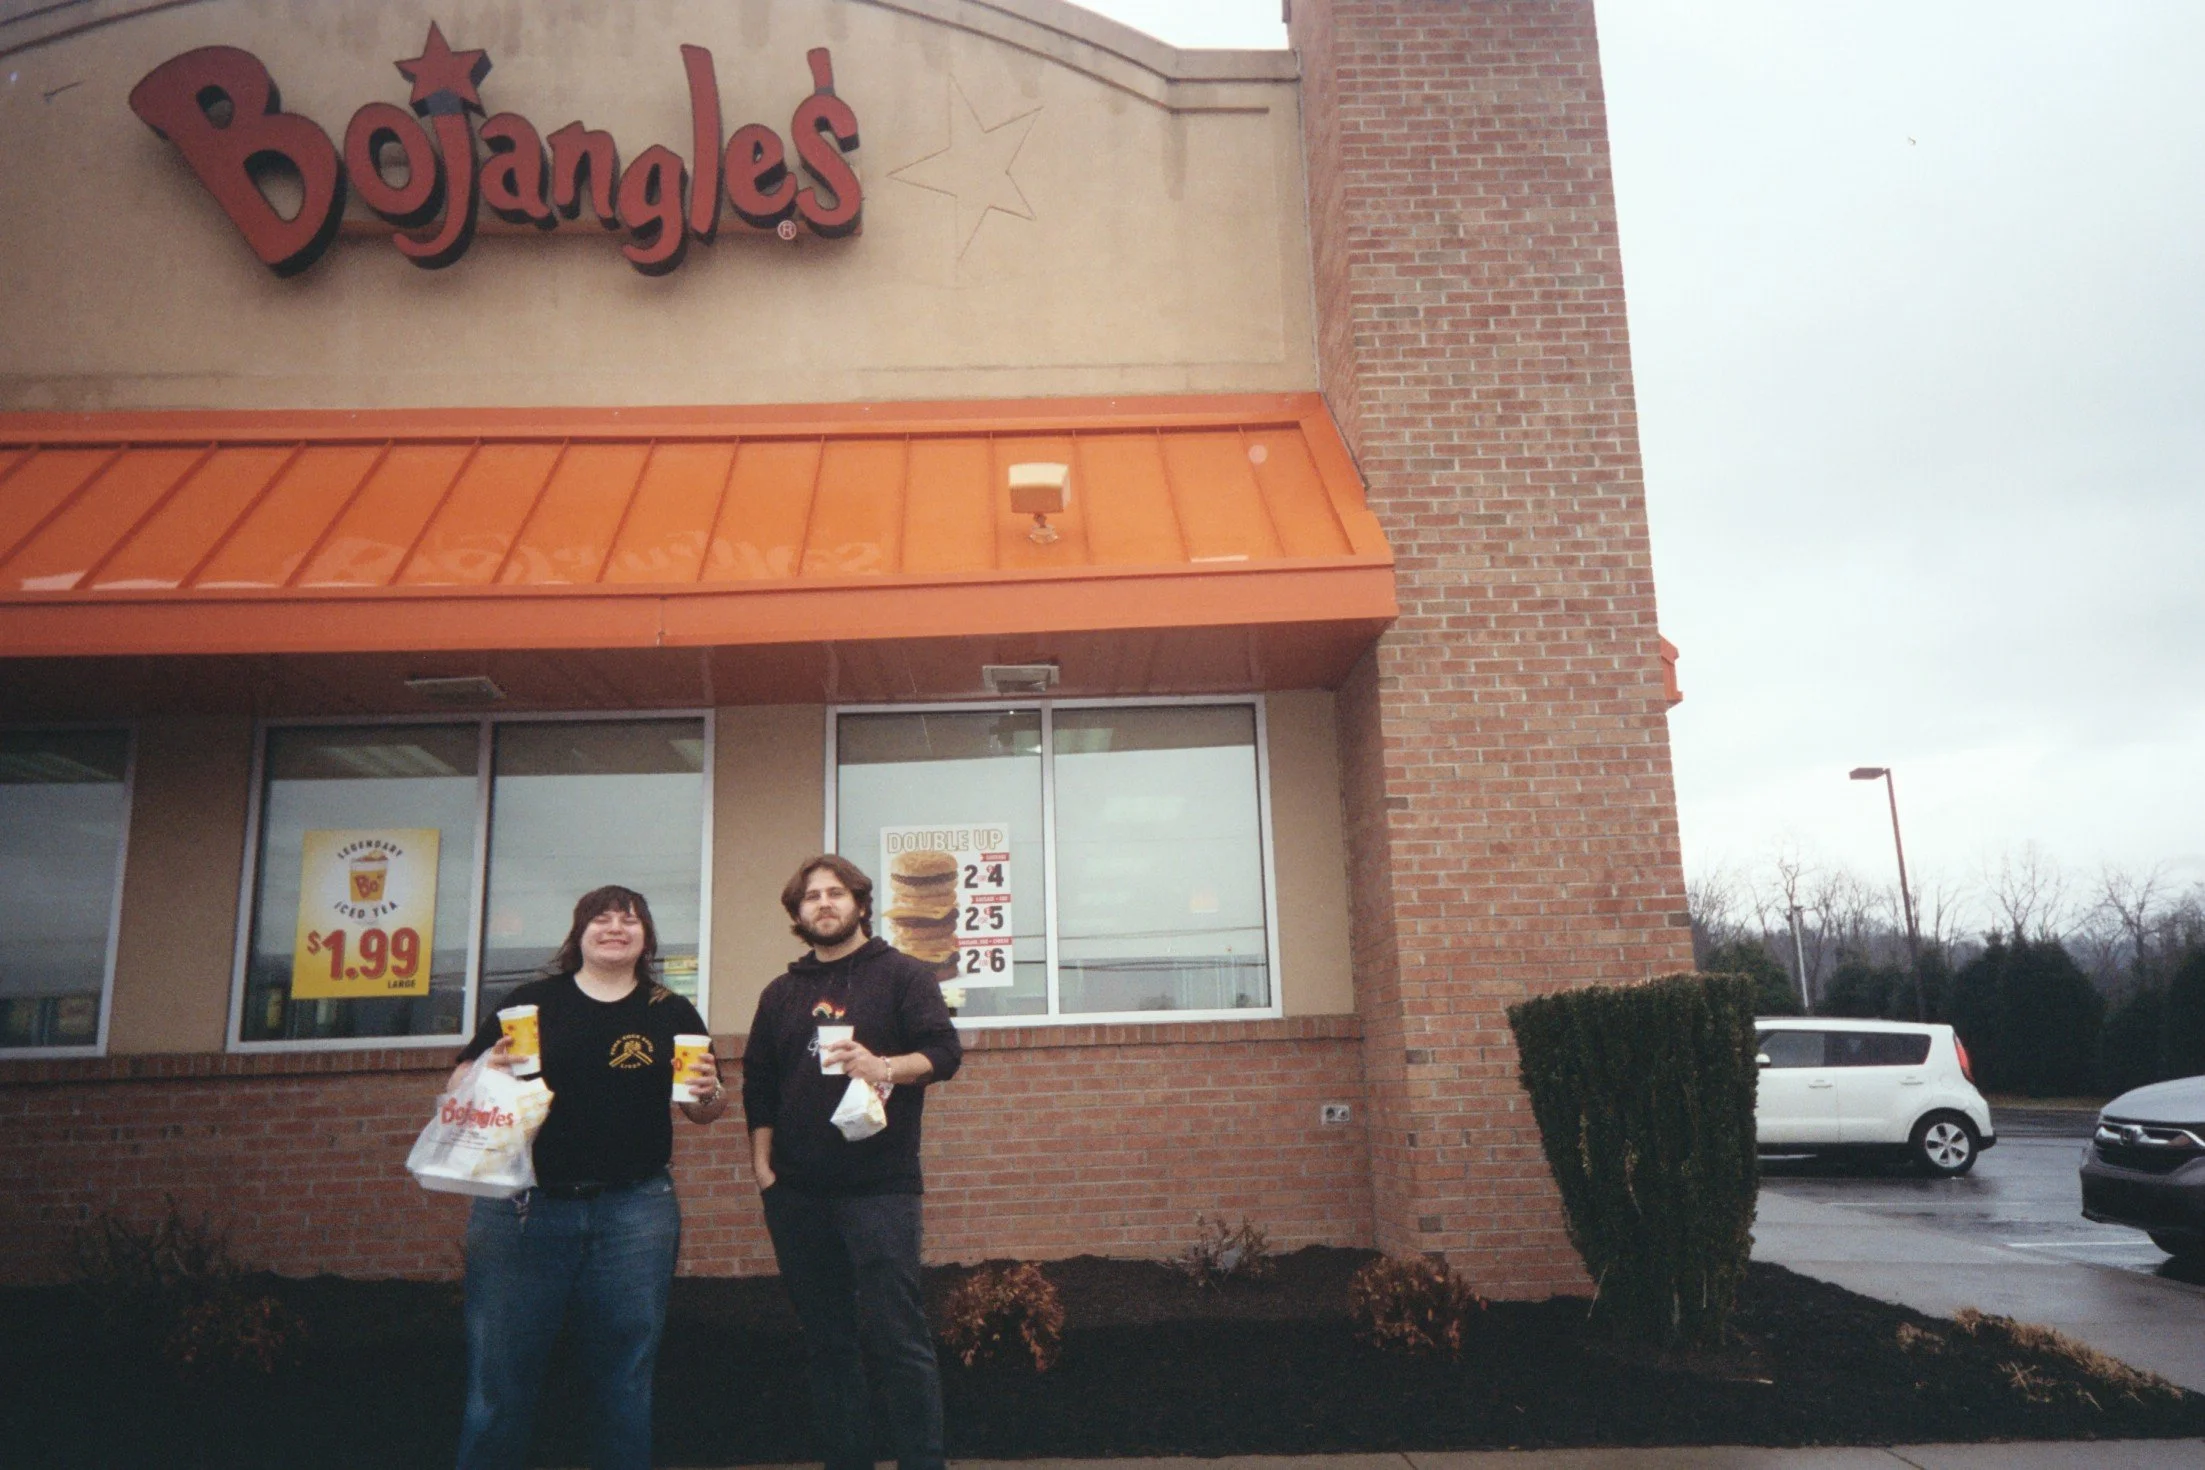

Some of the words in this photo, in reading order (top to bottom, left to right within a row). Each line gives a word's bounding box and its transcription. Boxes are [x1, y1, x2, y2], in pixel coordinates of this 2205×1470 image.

[337, 840, 403, 860] LEGENDARY
[887, 830, 969, 853] DOUBLE
[974, 829, 1003, 850] UP
[964, 864, 978, 889] 2
[334, 901, 365, 919] ICED
[372, 901, 398, 917] TEA
[965, 906, 980, 931] 2
[307, 927, 420, 981] $1.99
[966, 949, 981, 974] 2
[387, 980, 416, 989] LARGE
